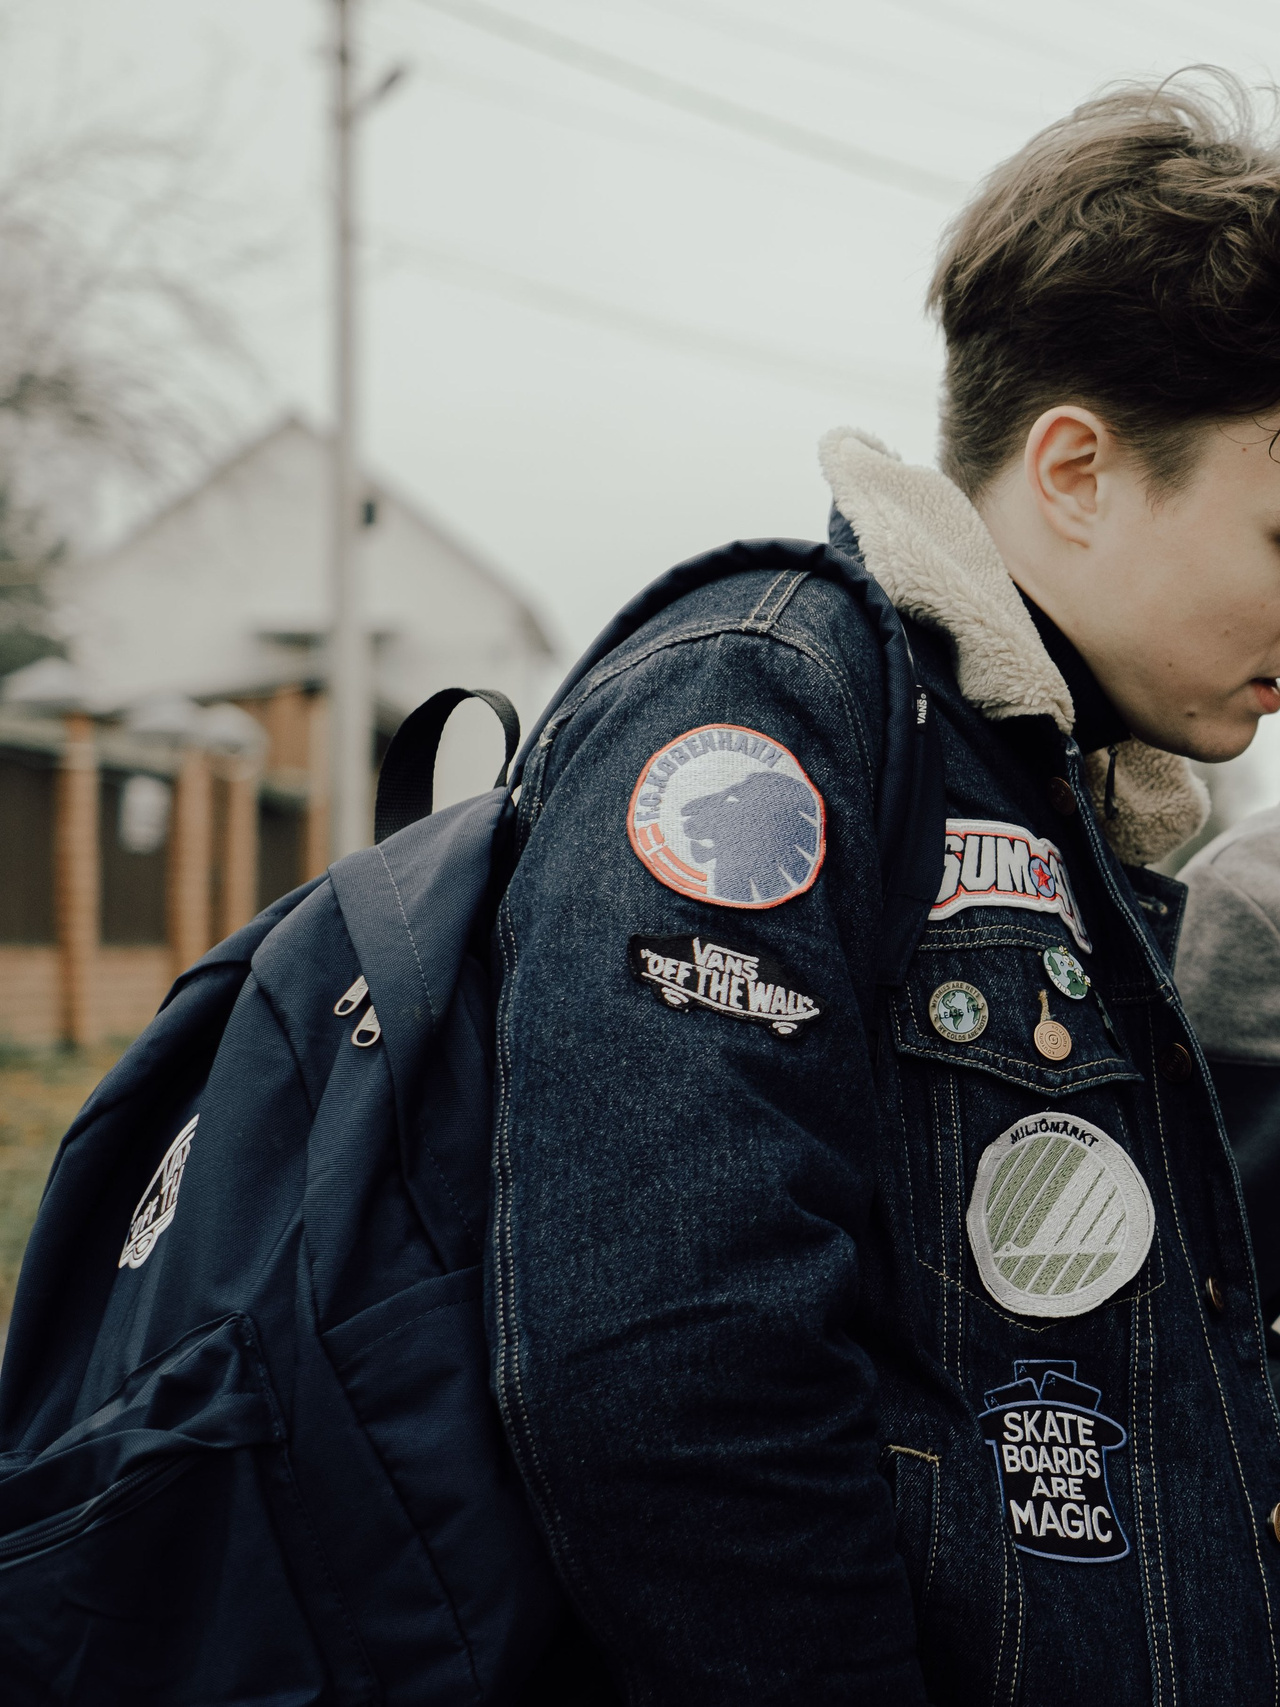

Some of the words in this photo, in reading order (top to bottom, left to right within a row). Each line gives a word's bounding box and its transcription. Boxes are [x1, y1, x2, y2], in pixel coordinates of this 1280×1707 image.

[917, 699, 928, 725] VANS
[692, 937, 760, 981] VANS
[696, 965, 746, 1010] THE
[1002, 1410, 1097, 1447] SKATE
[1002, 1444, 1101, 1479] BOARDS
[1031, 1475, 1087, 1501] ARE
[1009, 1500, 1113, 1543] MAGIC
